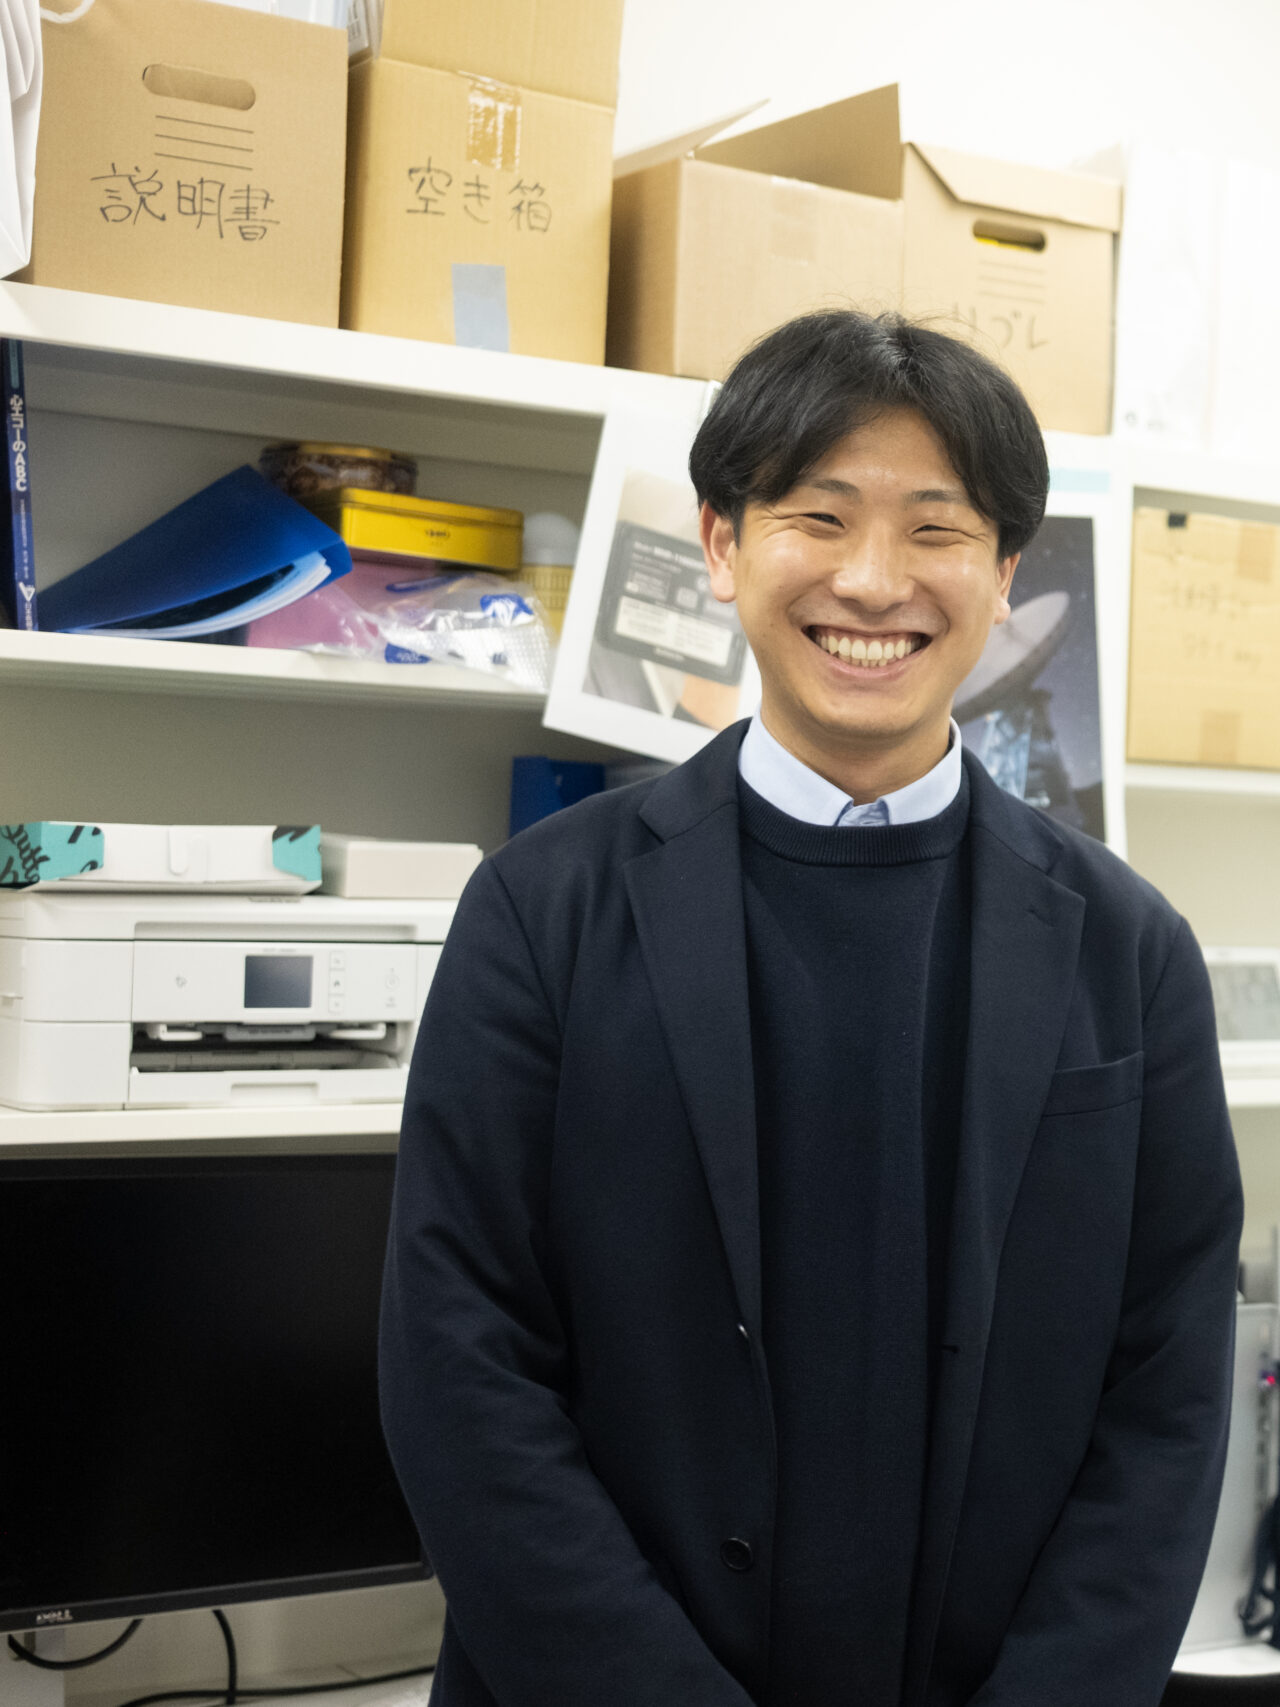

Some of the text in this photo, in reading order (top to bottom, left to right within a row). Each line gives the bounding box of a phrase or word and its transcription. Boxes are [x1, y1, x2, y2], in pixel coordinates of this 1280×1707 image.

[90, 161, 281, 241] 説明書
[406, 156, 552, 232] 空き箱
